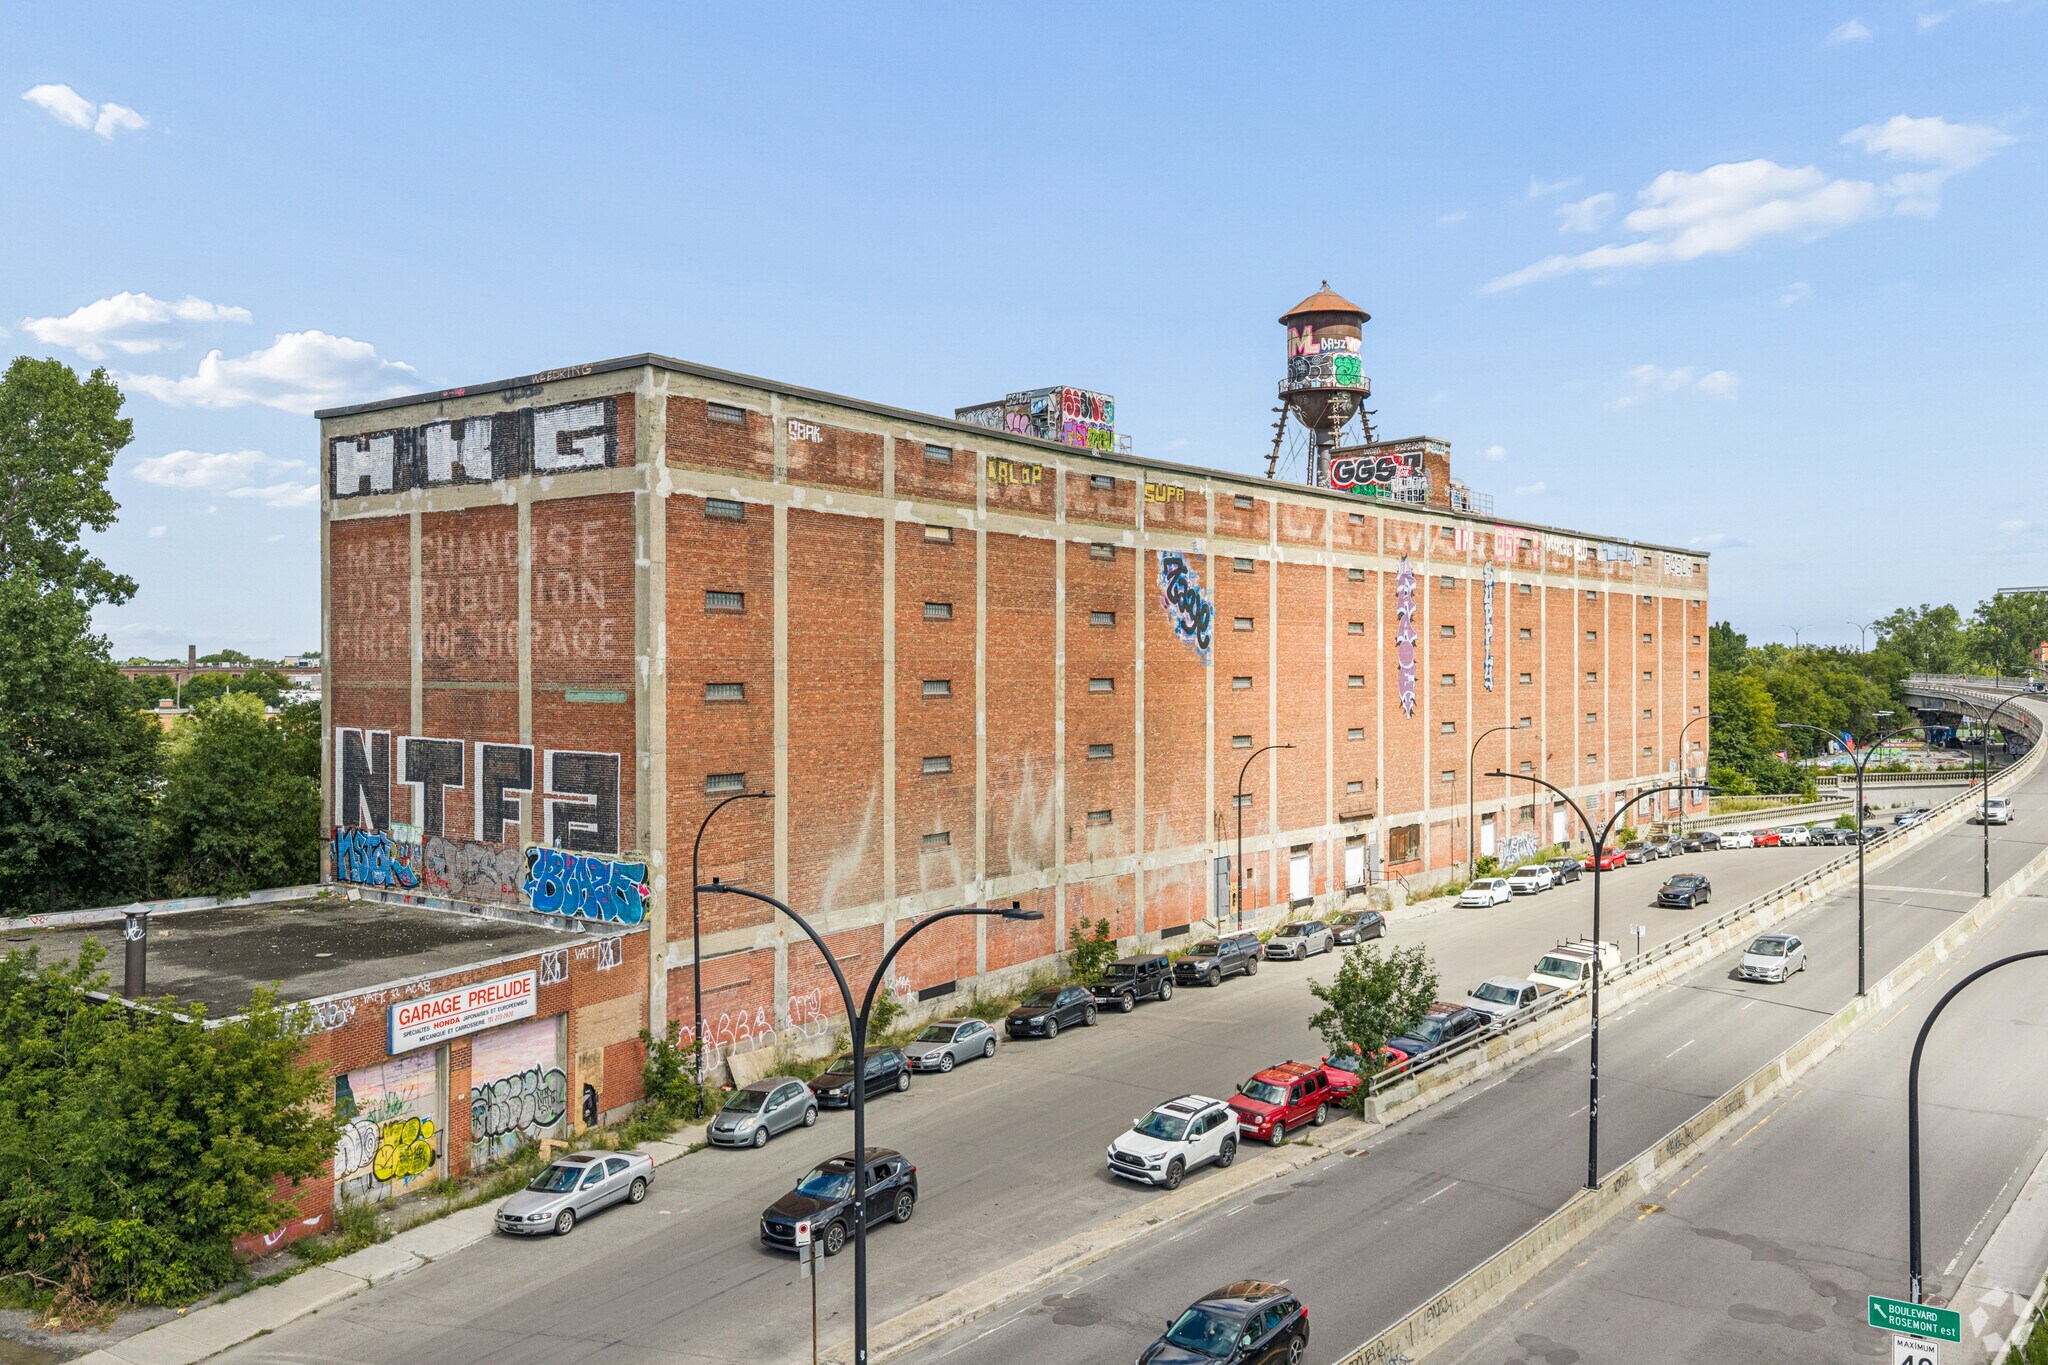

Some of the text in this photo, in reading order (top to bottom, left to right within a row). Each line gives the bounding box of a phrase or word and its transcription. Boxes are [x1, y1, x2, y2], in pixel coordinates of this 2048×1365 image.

[531, 364, 593, 384] WEEDKING
[347, 571, 605, 617] DISRIBUION
[399, 977, 531, 1026] GARAGE PRELUDE
[433, 1017, 460, 1029] HONDA
[463, 1010, 489, 1022] JAPONAISES
[447, 1027, 454, 1035] ET
[455, 1019, 486, 1033] CARROSSERIE
[1888, 1304, 1938, 1322] BOULEVARD
[1888, 1315, 1956, 1337] ROSEMONT est
[1896, 1340, 1935, 1353] MAXIMUM
